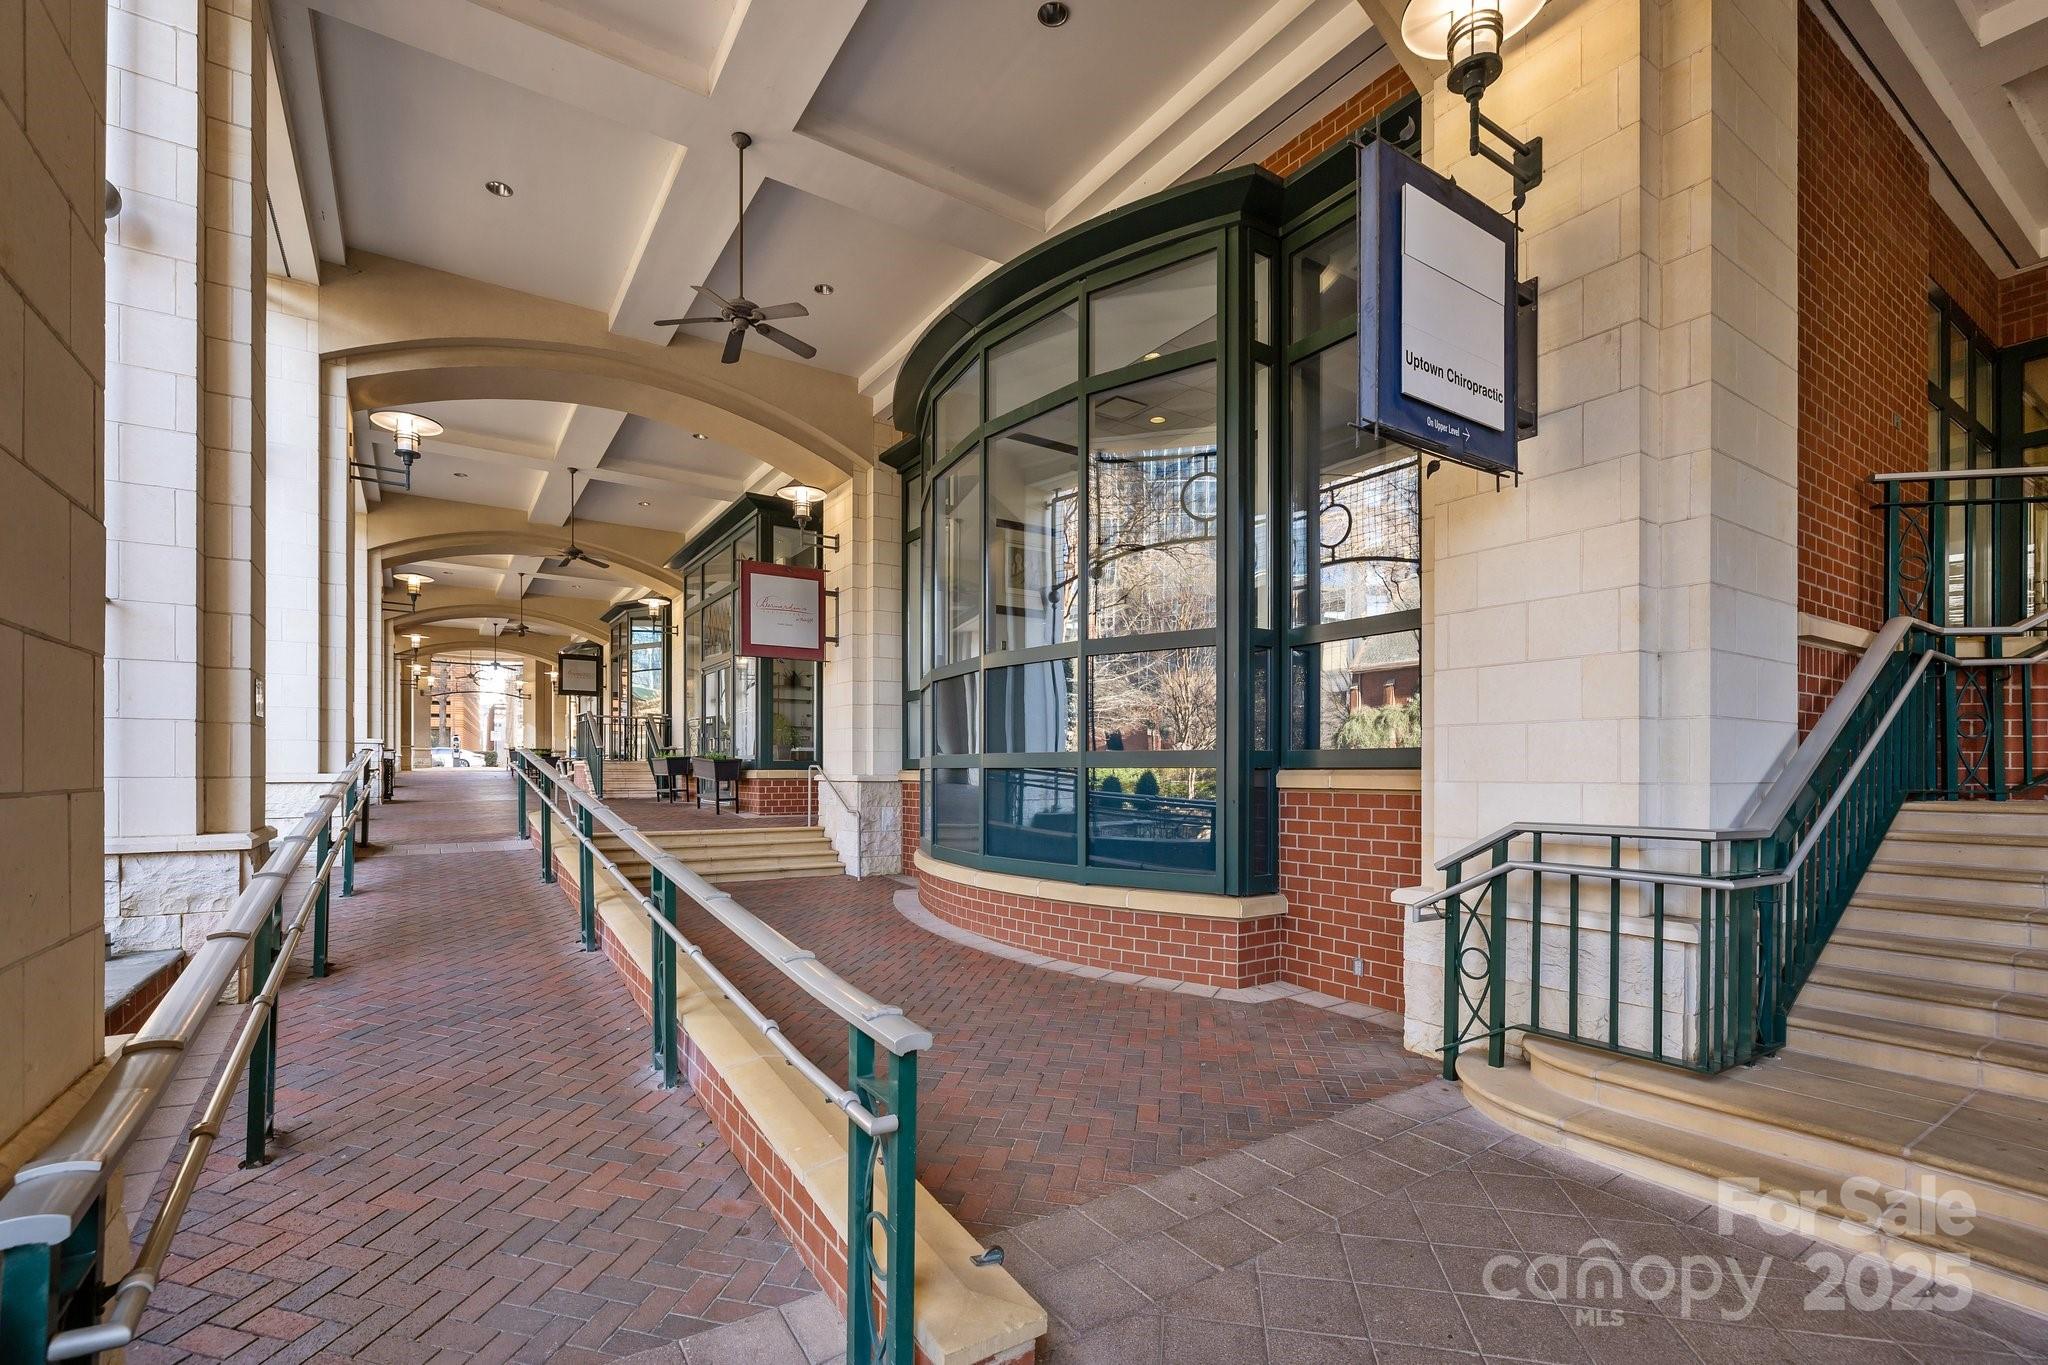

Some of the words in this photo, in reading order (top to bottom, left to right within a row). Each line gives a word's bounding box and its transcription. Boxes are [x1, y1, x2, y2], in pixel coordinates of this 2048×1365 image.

[1405, 349, 1444, 379] Uptown
[1447, 368, 1504, 404] Chiropractic
[1426, 416, 1434, 426] On
[1434, 418, 1448, 432] Upper
[1448, 424, 1460, 437] Level
